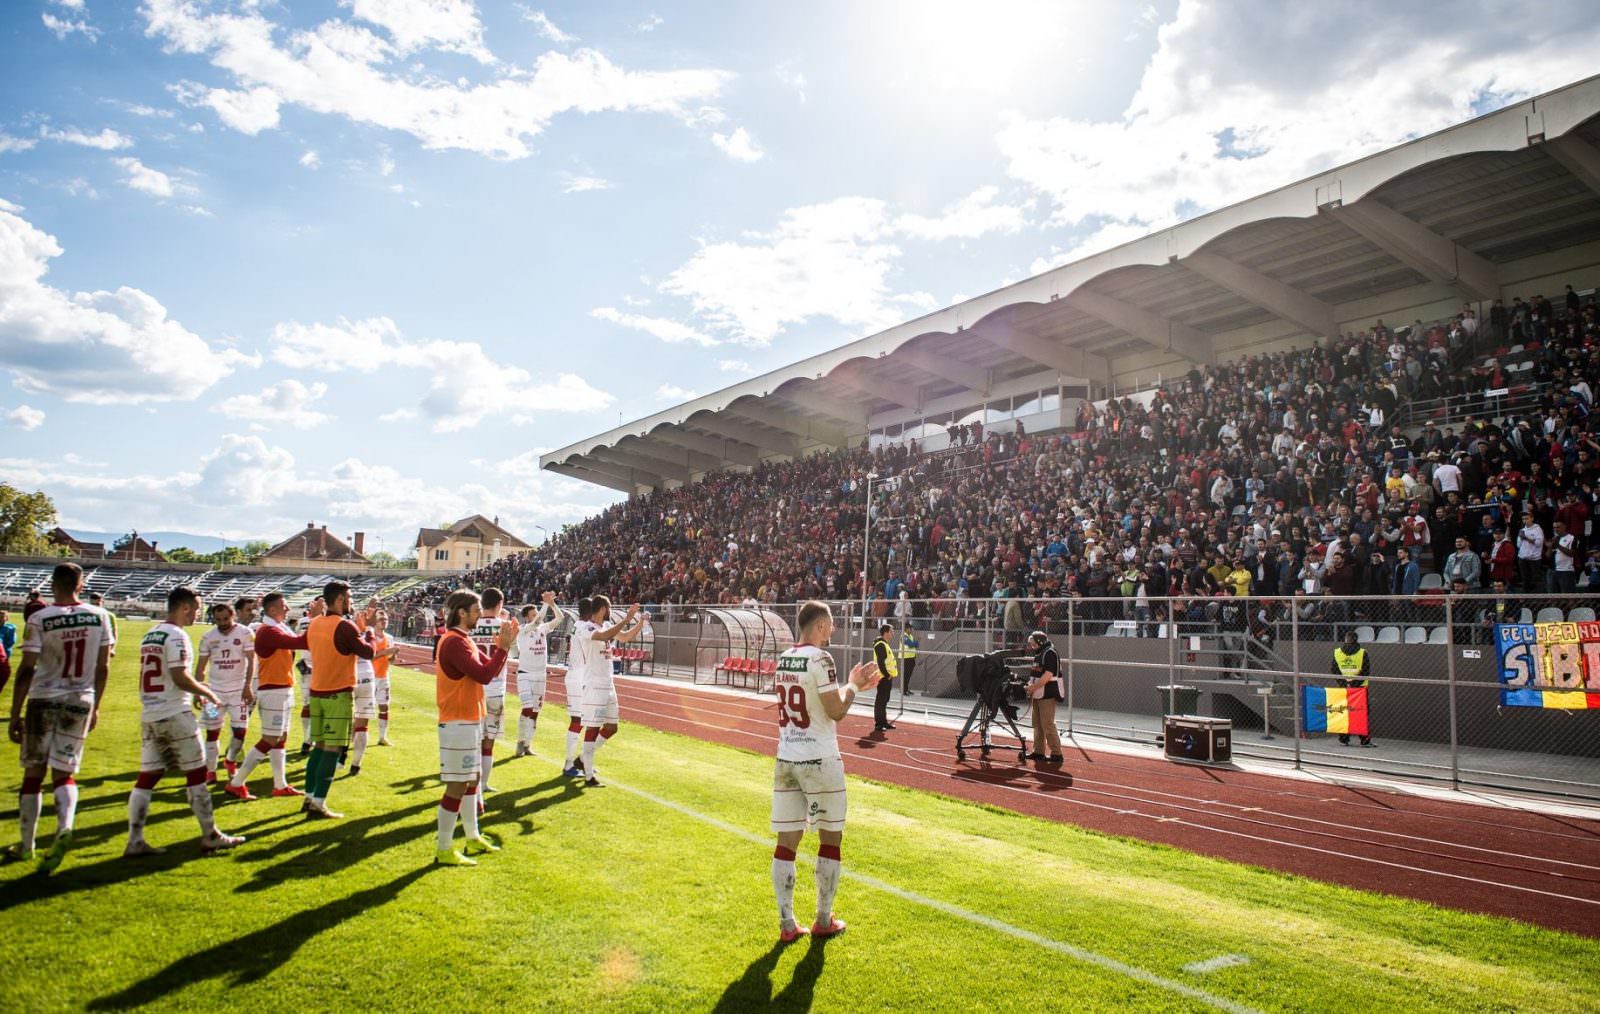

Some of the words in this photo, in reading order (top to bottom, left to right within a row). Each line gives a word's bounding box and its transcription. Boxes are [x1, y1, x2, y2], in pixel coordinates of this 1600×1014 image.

[77, 614, 97, 624] bet
[1501, 623, 1577, 640] PELUZA
[61, 638, 86, 678] 11
[221, 649, 231, 659] 17
[776, 684, 811, 729] 89
